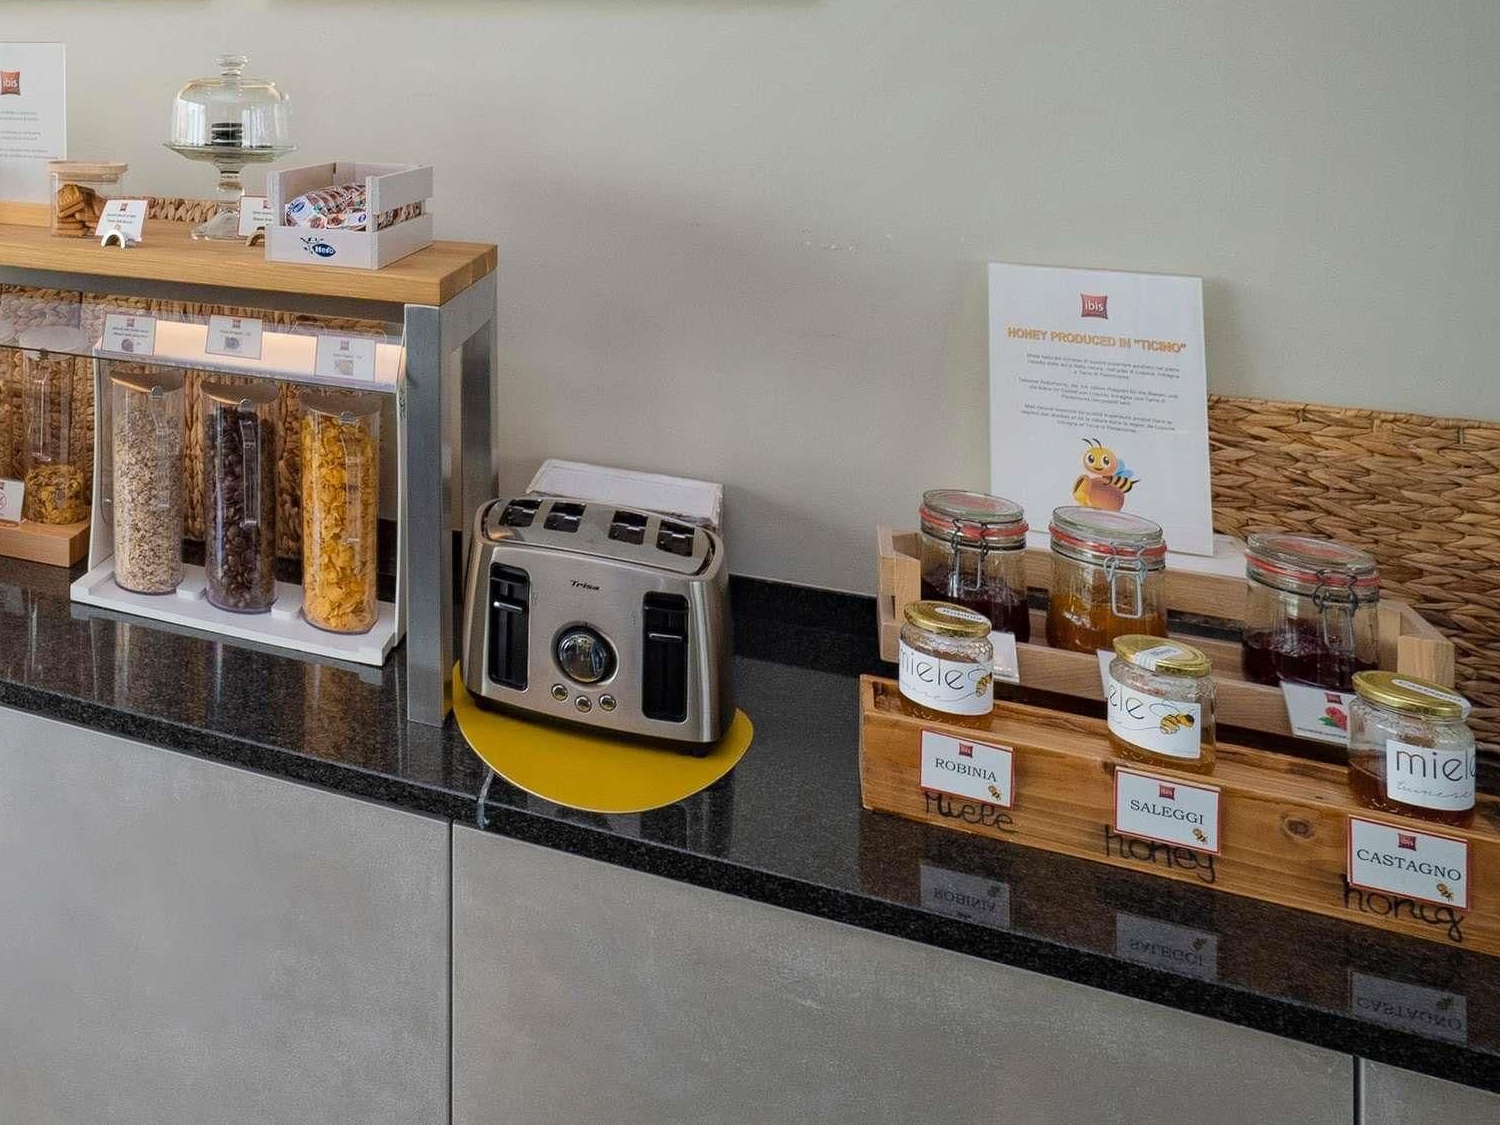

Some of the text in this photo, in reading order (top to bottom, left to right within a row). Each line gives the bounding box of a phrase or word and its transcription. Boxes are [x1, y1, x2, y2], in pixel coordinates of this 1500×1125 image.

[1084, 299, 1105, 312] ibis
[1007, 326, 1187, 354] HONEY PRODUCED IN "TICINO"
[569, 578, 601, 591] Trisa
[935, 757, 998, 783] ROBINIA
[1129, 799, 1205, 825] SALEGGI
[1356, 848, 1462, 882] CASTAGNO
